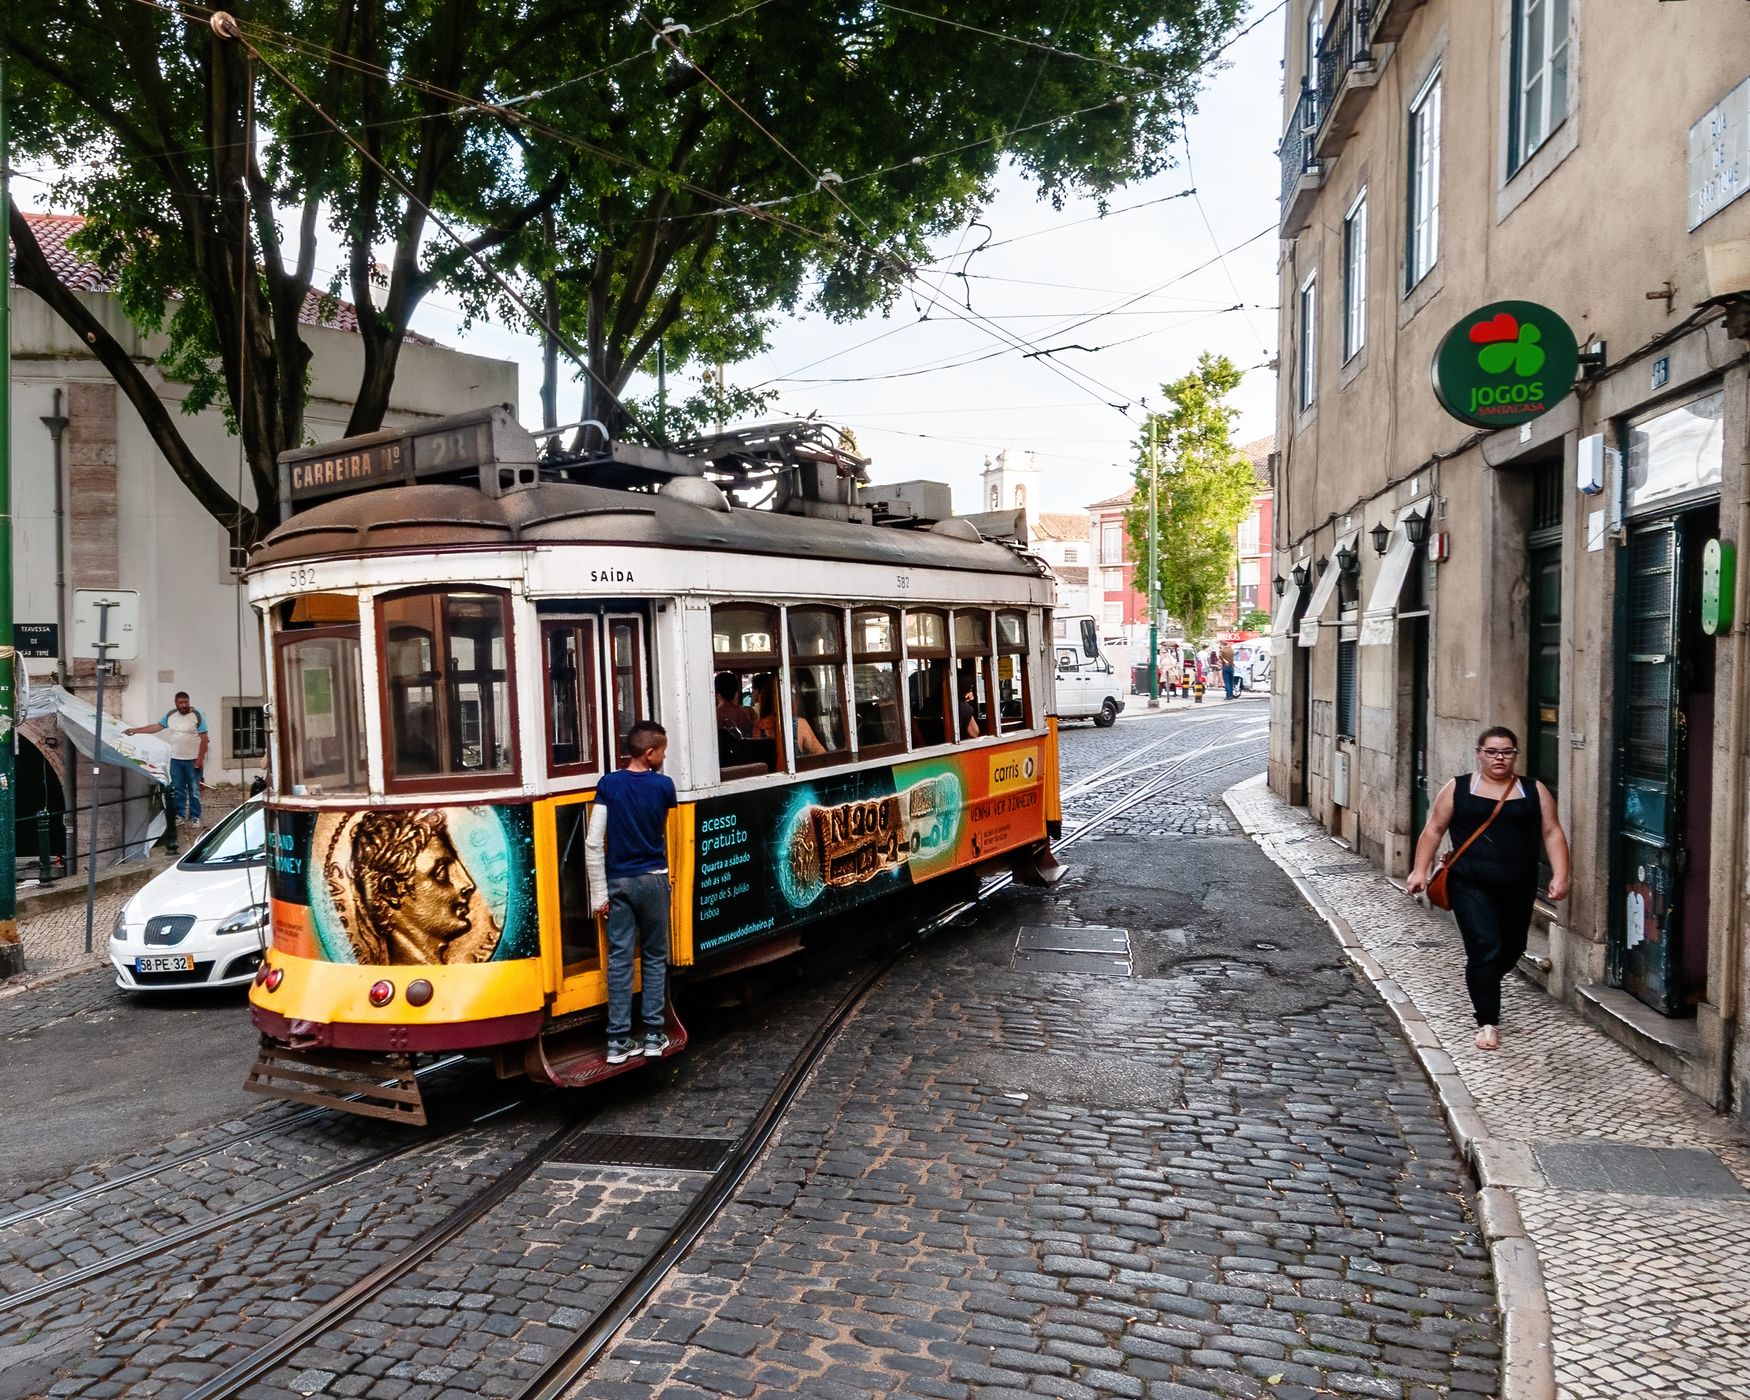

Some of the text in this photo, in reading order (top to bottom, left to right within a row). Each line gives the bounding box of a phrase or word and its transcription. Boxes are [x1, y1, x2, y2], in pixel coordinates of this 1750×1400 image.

[1470, 381, 1545, 412] JOGOS
[293, 452, 372, 489] CARREIRA
[290, 568, 316, 587] 582
[590, 567, 635, 583] SAÍDA
[896, 575, 910, 589] 582
[994, 759, 1020, 783] carris
[701, 814, 737, 832] acesso
[701, 829, 748, 856] gratuito
[701, 860, 723, 875] Quarta
[724, 860, 729, 868] a
[700, 893, 718, 905] Largo
[719, 889, 726, 899] de
[700, 907, 720, 920] Lisboa
